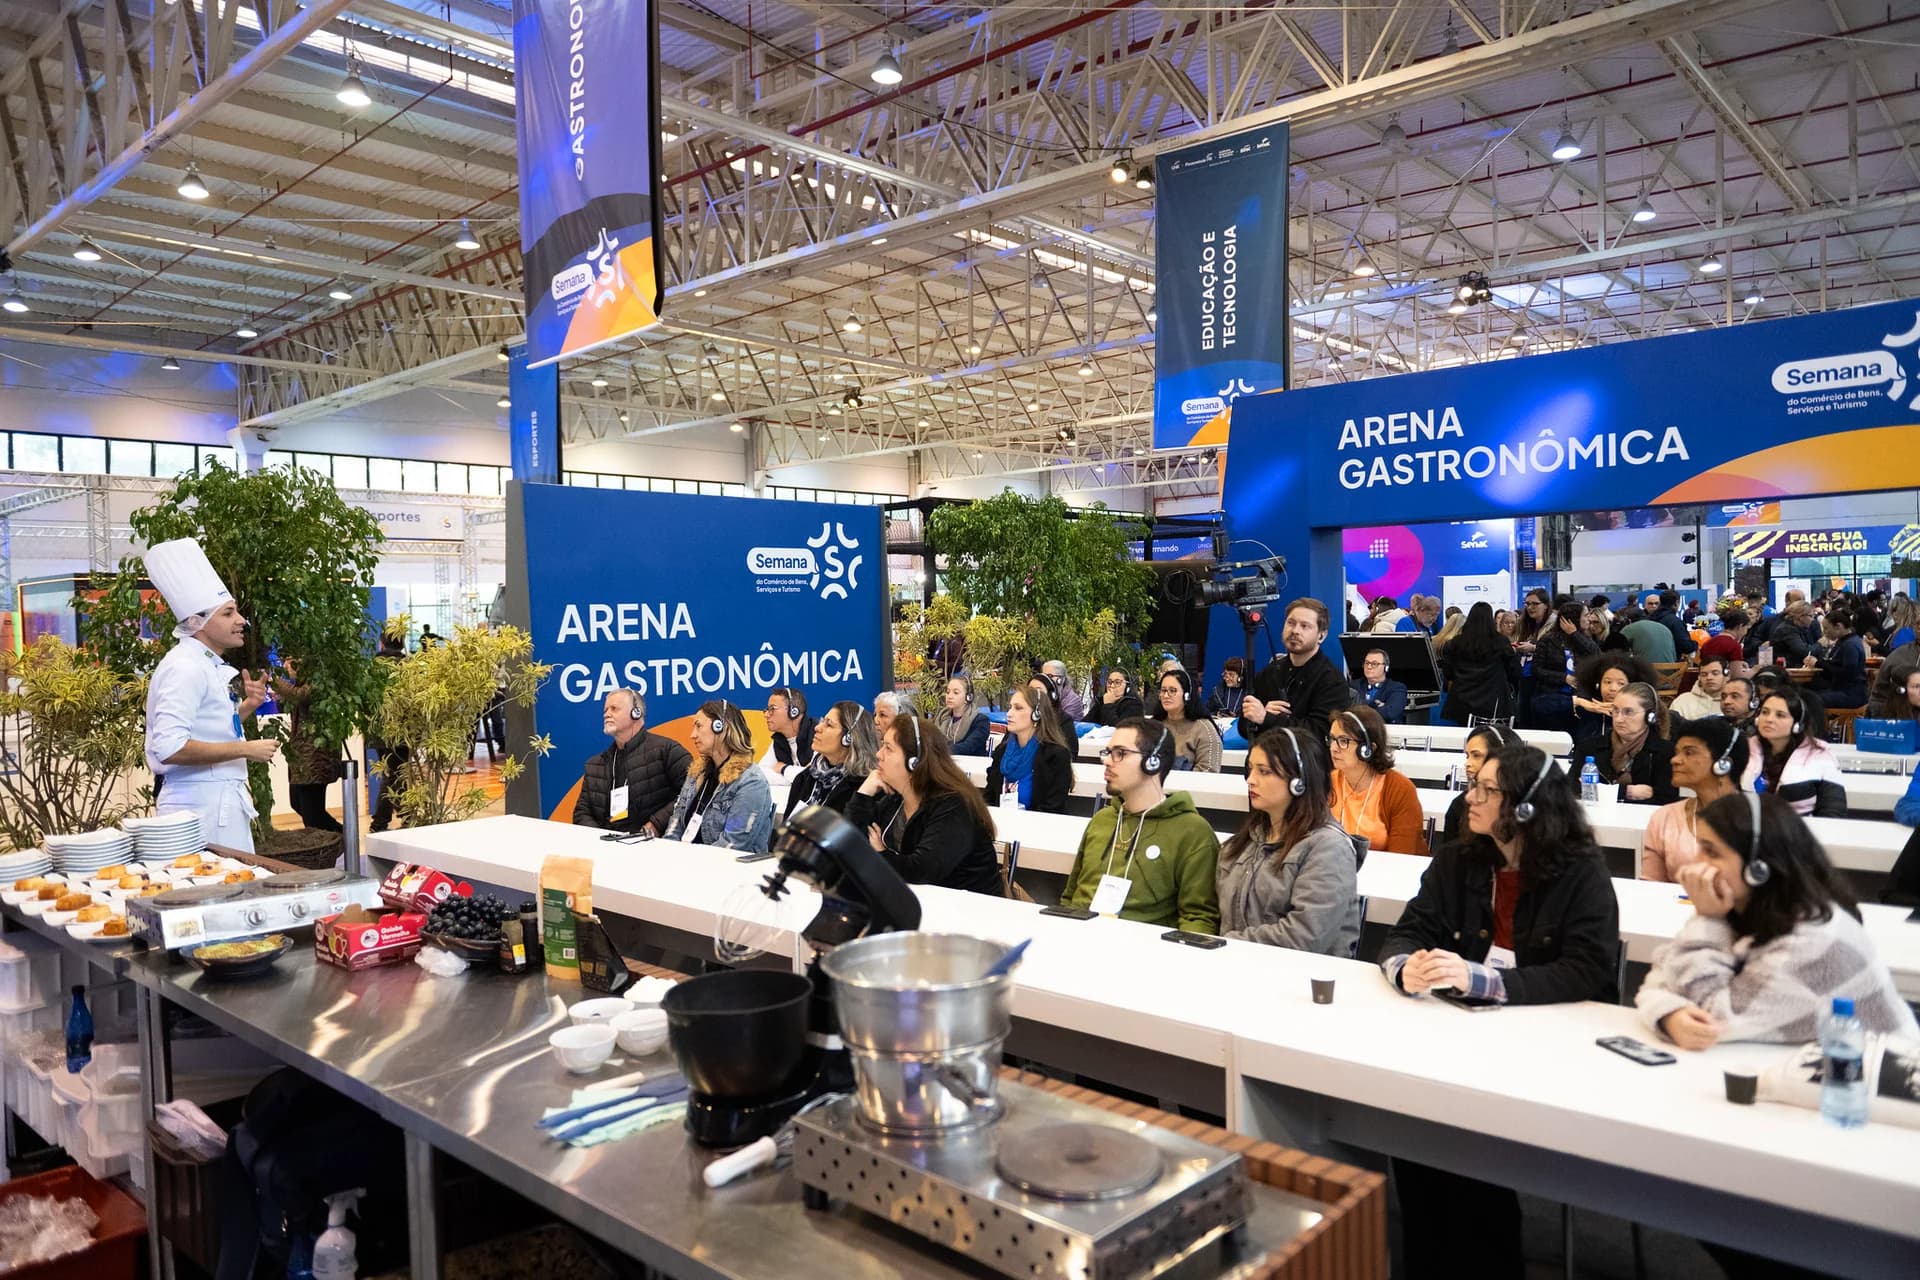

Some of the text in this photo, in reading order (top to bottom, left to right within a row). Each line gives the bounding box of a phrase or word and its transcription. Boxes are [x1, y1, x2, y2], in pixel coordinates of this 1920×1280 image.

[569, 0, 585, 182] GASTRONO
[555, 272, 586, 294] Semana
[1199, 231, 1218, 350] EDUCAÇÃO E
[1223, 225, 1238, 348] TECNOLOGIA
[1787, 362, 1882, 386] Semana
[1186, 402, 1219, 412] Semana
[1787, 397, 1799, 406] do
[1800, 392, 1844, 405] Comércio
[1845, 391, 1857, 399] de
[1787, 405, 1825, 415] Serviços
[1833, 400, 1868, 410] Turismo
[531, 411, 539, 467] ESPORTES
[1338, 406, 1465, 451] ARENA
[1338, 425, 1690, 490] GASTRONÔMICA
[1785, 539, 1868, 553] INSCRIÇÃO!
[1789, 530, 1863, 544] FAÇA SUA
[756, 553, 807, 568] Semana
[557, 602, 697, 643] ARENA
[559, 642, 864, 703] GASTRONÔMICA
